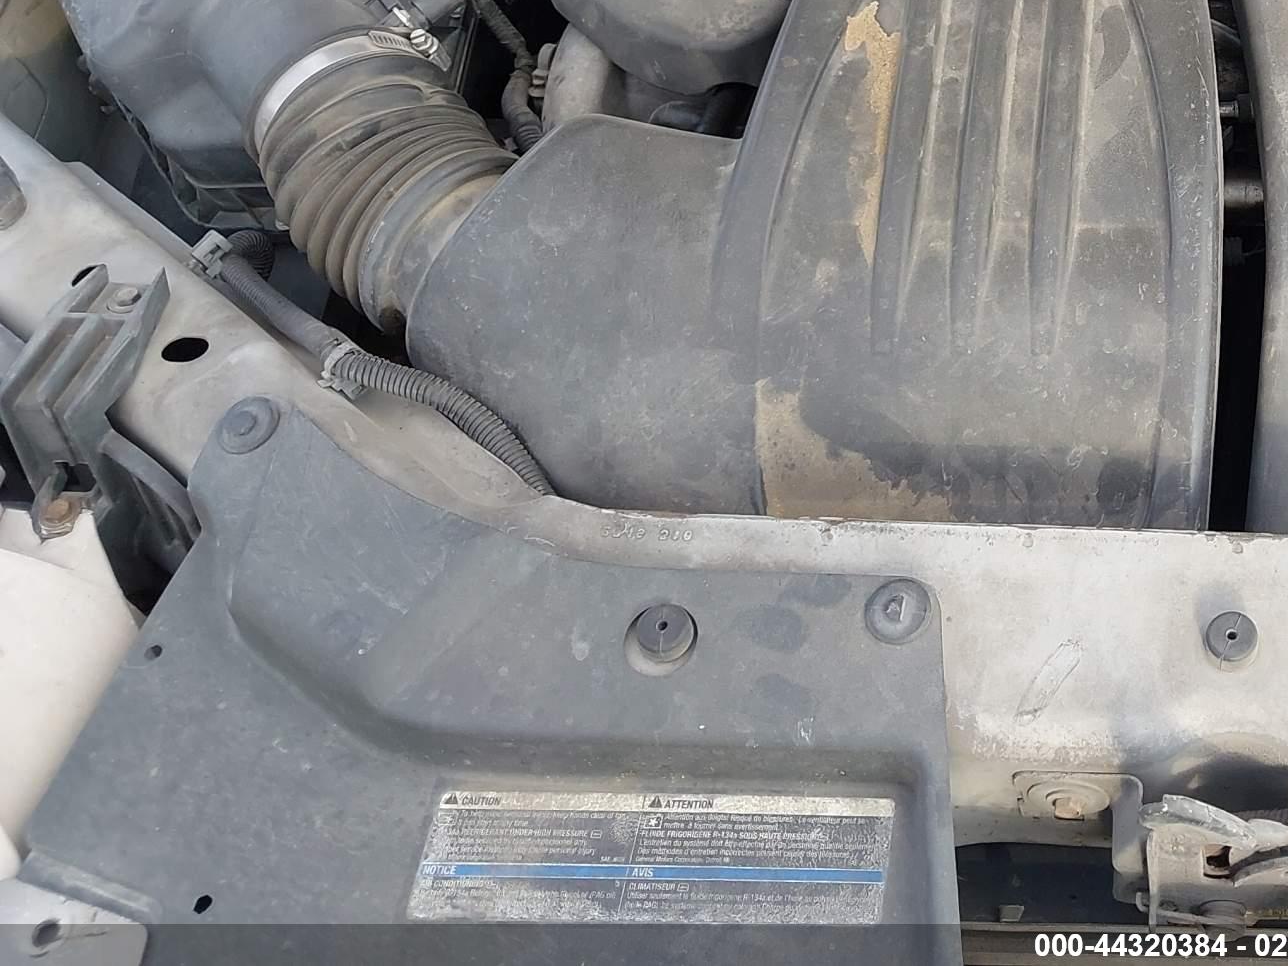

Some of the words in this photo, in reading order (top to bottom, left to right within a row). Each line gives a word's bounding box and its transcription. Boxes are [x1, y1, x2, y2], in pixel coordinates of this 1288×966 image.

[462, 797, 501, 806] CAUTION
[664, 799, 714, 809] ATTENTION
[422, 865, 457, 875] NOTICE
[632, 867, 654, 877] AVIS
[628, 882, 675, 891] CLIMATISEUR
